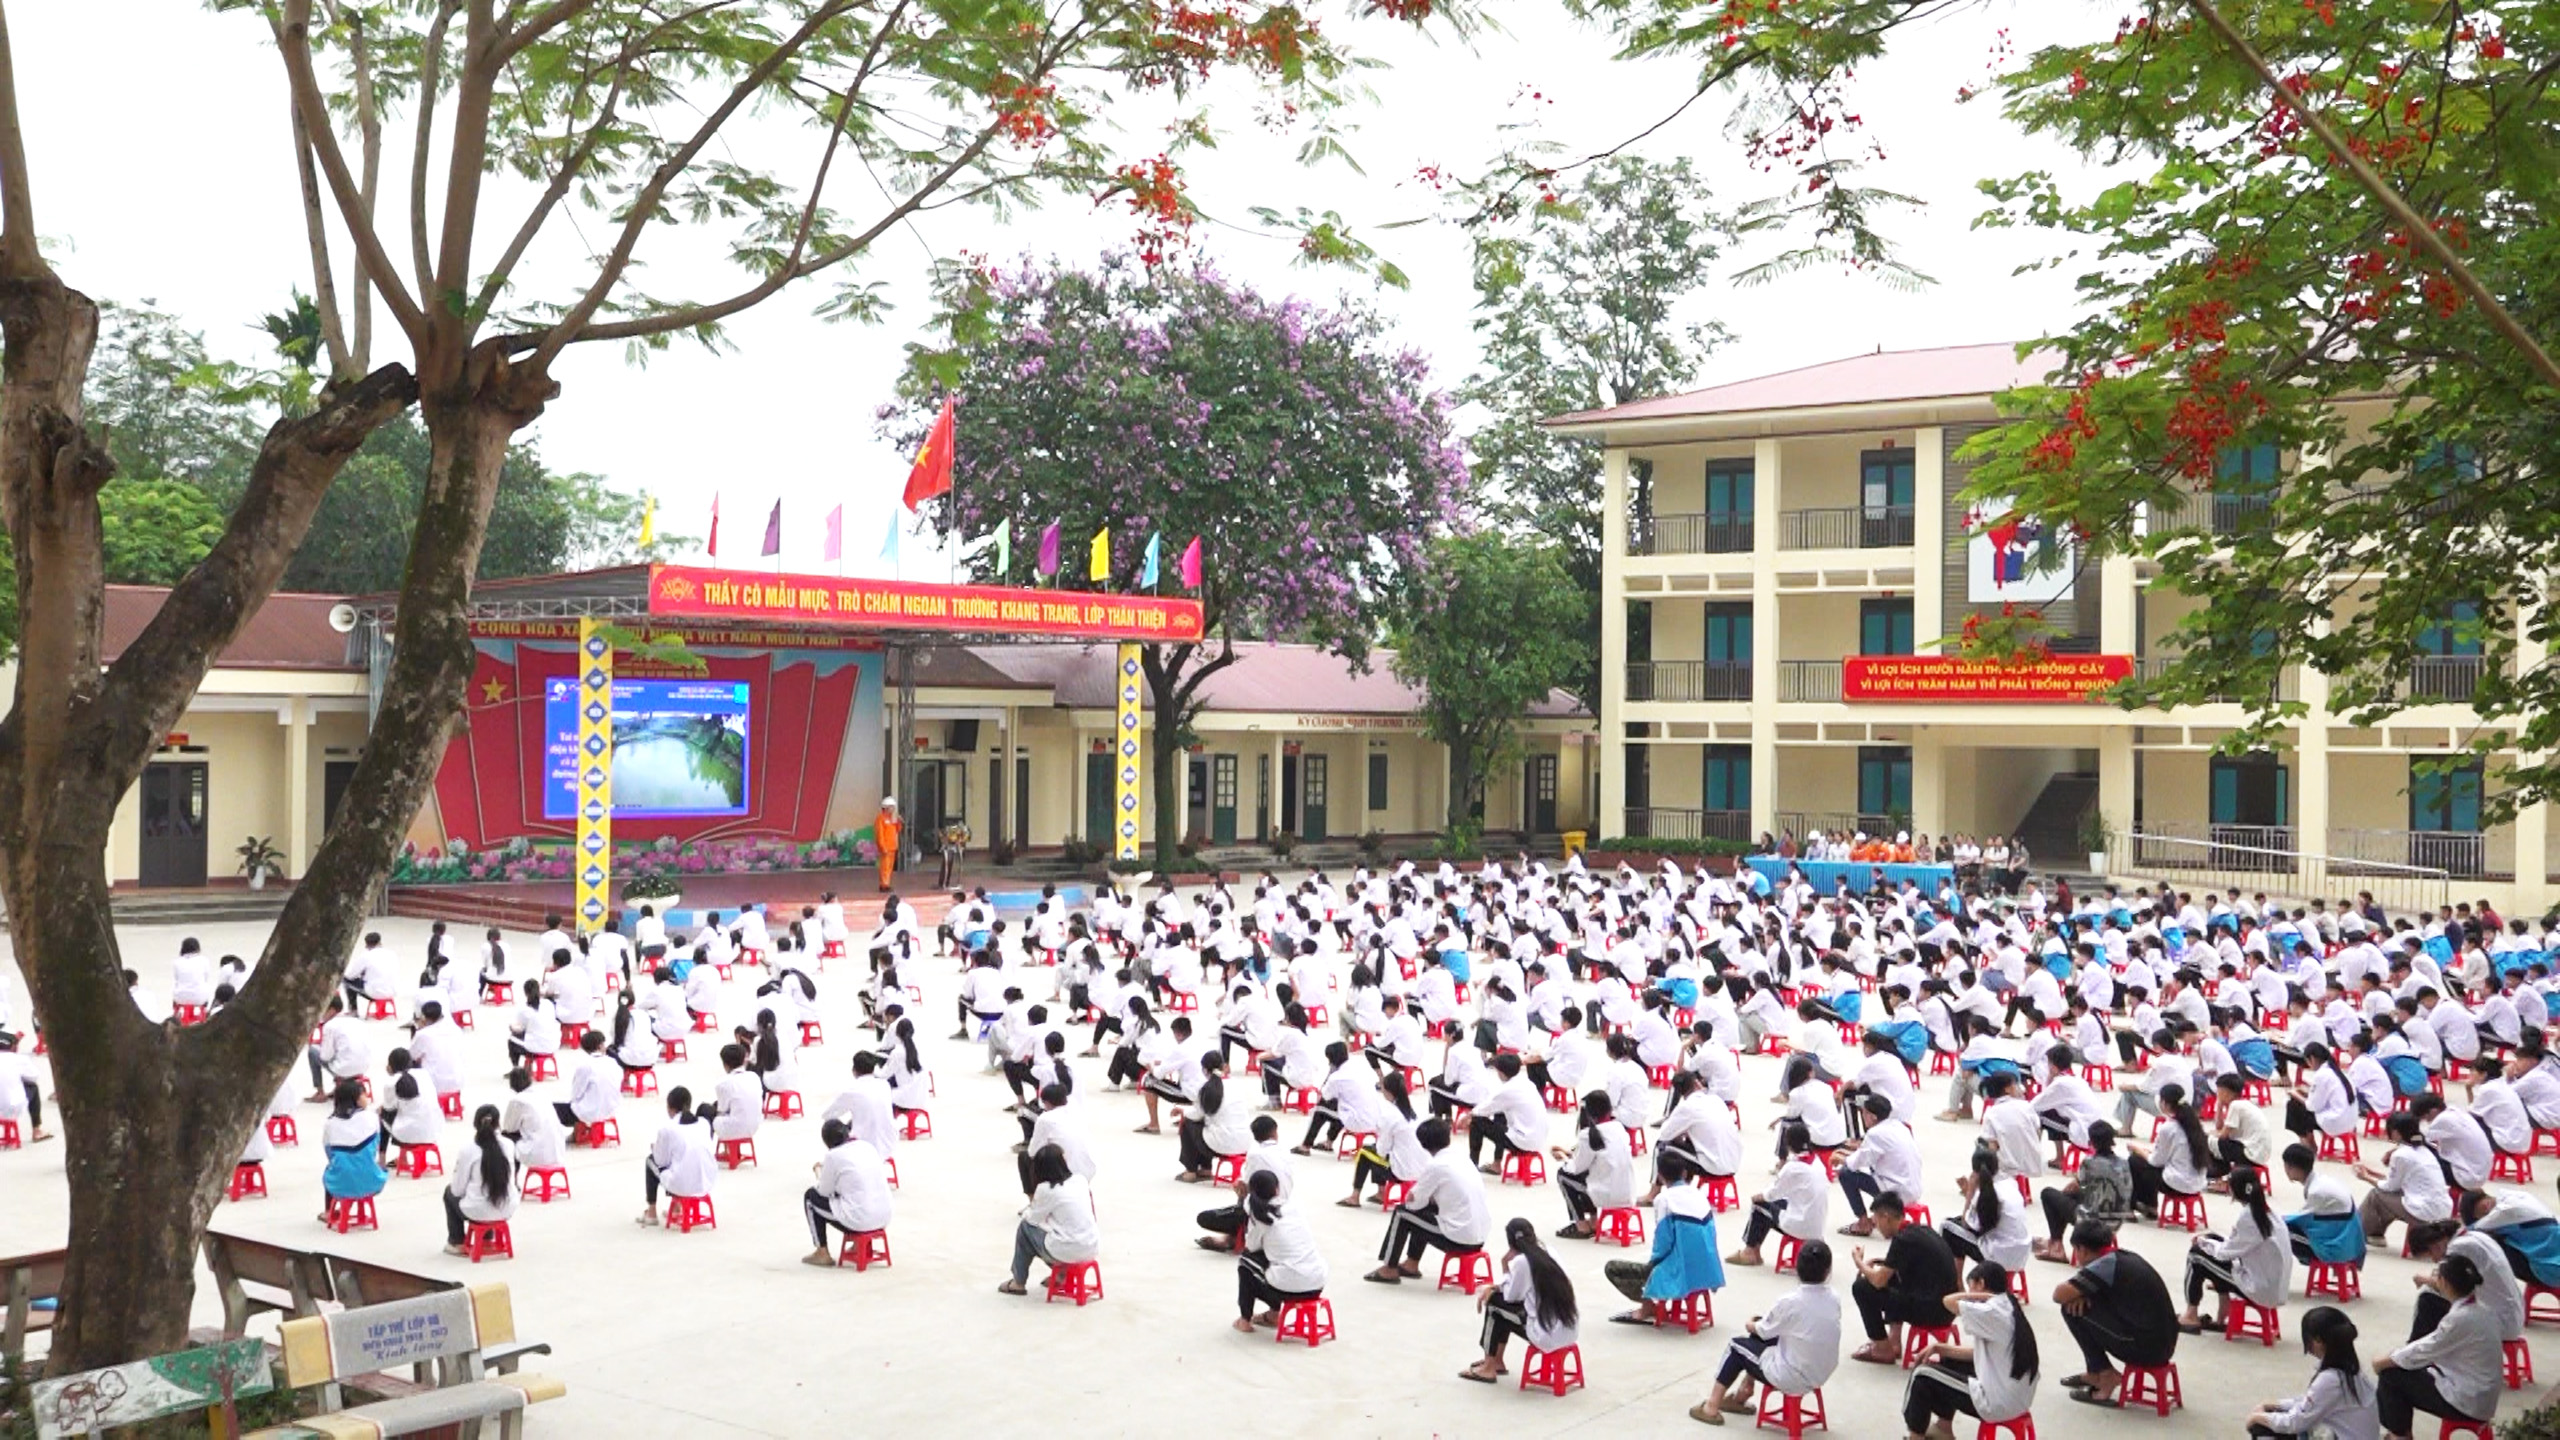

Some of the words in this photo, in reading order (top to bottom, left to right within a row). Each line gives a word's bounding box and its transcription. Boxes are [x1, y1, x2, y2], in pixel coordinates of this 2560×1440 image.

[743, 582, 761, 607] CÔ
[836, 587, 860, 613] TRÒ
[903, 595, 946, 617] NGOAN
[1001, 600, 1040, 622] KHANG
[1042, 603, 1082, 626] TRANG,
[1867, 663, 1878, 675] VÌ
[1901, 662, 1921, 675] ÍCH
[2079, 662, 2105, 675] CÂY
[1860, 677, 1872, 690] VÌ
[1894, 677, 1914, 690] ÍCH
